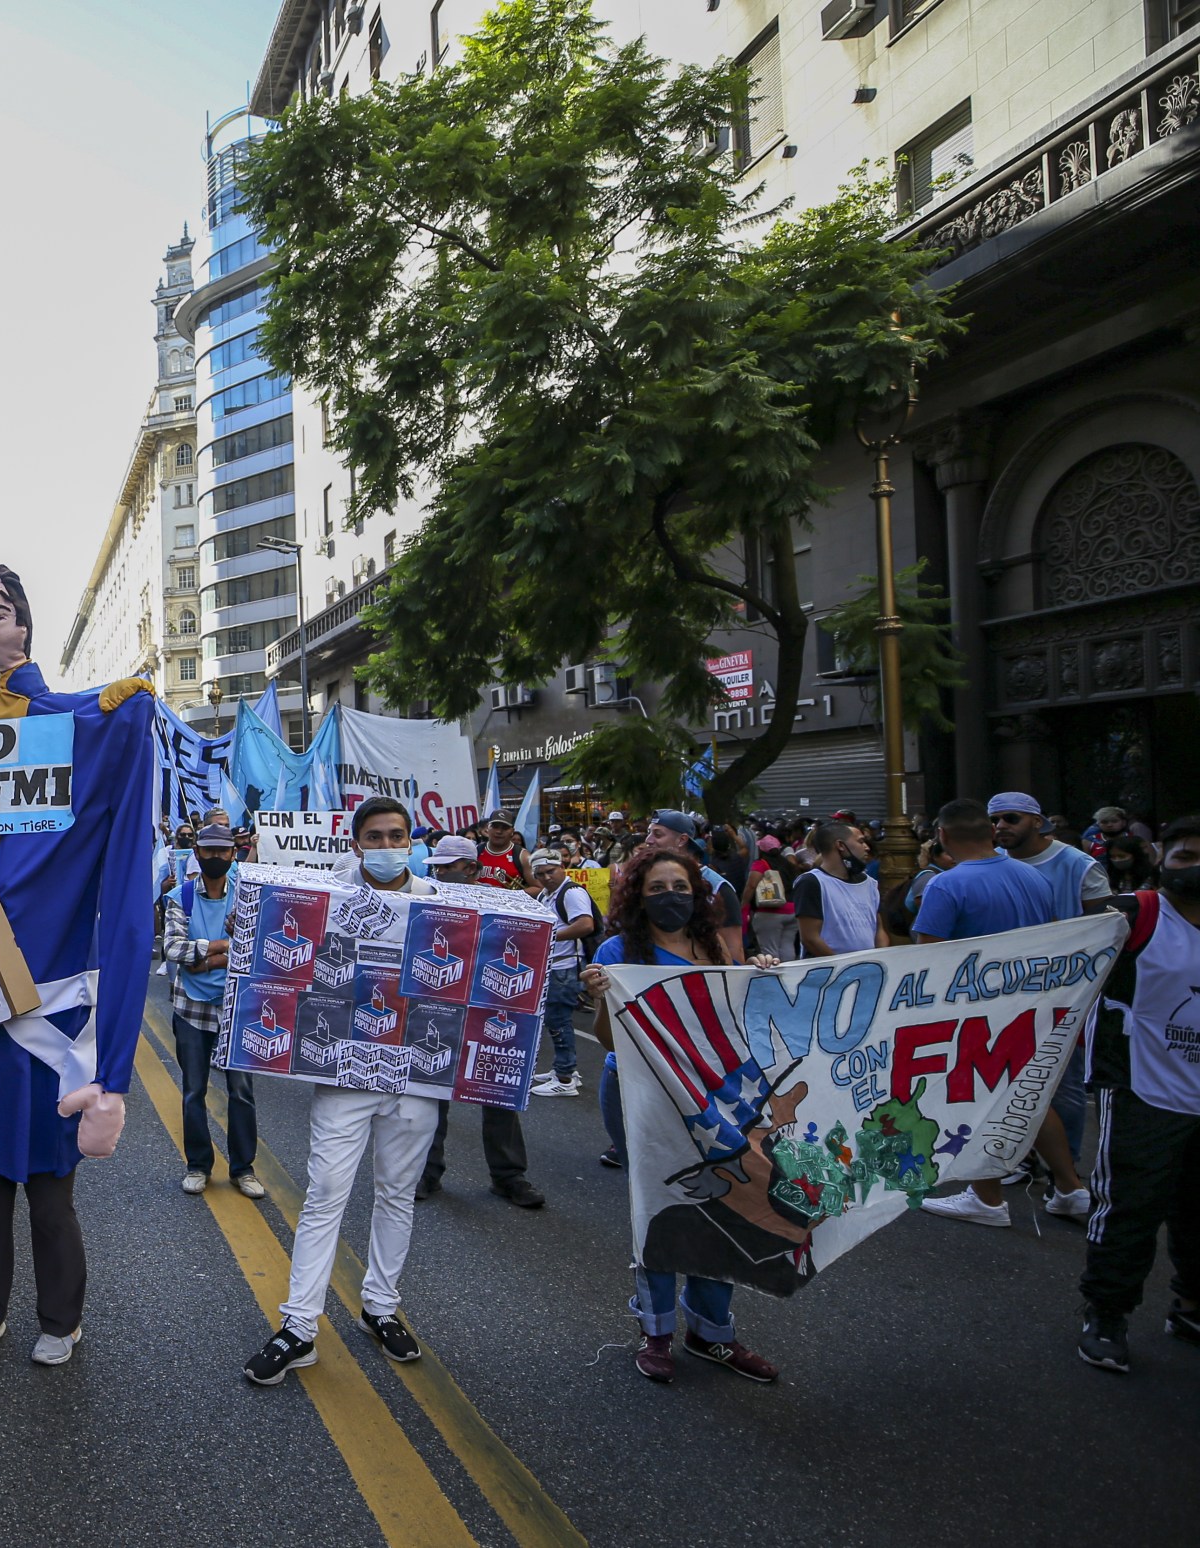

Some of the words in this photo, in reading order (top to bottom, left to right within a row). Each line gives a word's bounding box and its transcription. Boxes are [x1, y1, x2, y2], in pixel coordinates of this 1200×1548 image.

[720, 653, 748, 669] GINEVRA
[728, 700, 747, 708] VENTA
[537, 746, 543, 757] DE
[545, 730, 595, 761] Golosinas
[259, 812, 293, 828] CON
[304, 813, 321, 824] EL
[264, 939, 290, 958] CONSULTA
[289, 942, 313, 969] FMI
[263, 949, 289, 969] POPULAR
[314, 959, 334, 977] CONSULTA
[413, 957, 438, 976] CONSULTA
[314, 968, 334, 986] POPULAR
[334, 963, 355, 986] FMI
[412, 968, 438, 987] POPULAR
[438, 961, 464, 987] FMI
[483, 966, 508, 986] CONSULTA
[508, 970, 534, 997] FMI
[481, 976, 508, 996] POPULAR
[355, 1009, 377, 1025] CONSULTA
[377, 1011, 397, 1034] FMI
[743, 961, 884, 1069] NO
[889, 969, 935, 1011] AL
[354, 1018, 377, 1034] POPULAR
[484, 1022, 500, 1034] CONSULTA
[484, 1028, 500, 1040] POPULAR
[500, 1024, 517, 1040] FMI
[242, 1038, 267, 1058] POPULAR
[243, 1029, 268, 1048] CONSULTA
[267, 1033, 291, 1059] FMI
[302, 1039, 323, 1055] CONSULTA
[301, 1047, 322, 1064] POPULAR
[367, 1049, 381, 1064] FMI
[395, 1052, 410, 1065] FMI
[464, 1040, 479, 1080] 1
[478, 1053, 491, 1062] DE
[494, 1056, 525, 1067] VOTOS
[480, 1044, 526, 1059] MILLÓN
[431, 1050, 451, 1073] FMI
[476, 1062, 522, 1076] CONTRA
[831, 1040, 889, 1087] CON
[475, 1070, 491, 1082] EL
[494, 1073, 522, 1086] FMI
[851, 1073, 888, 1113] EL
